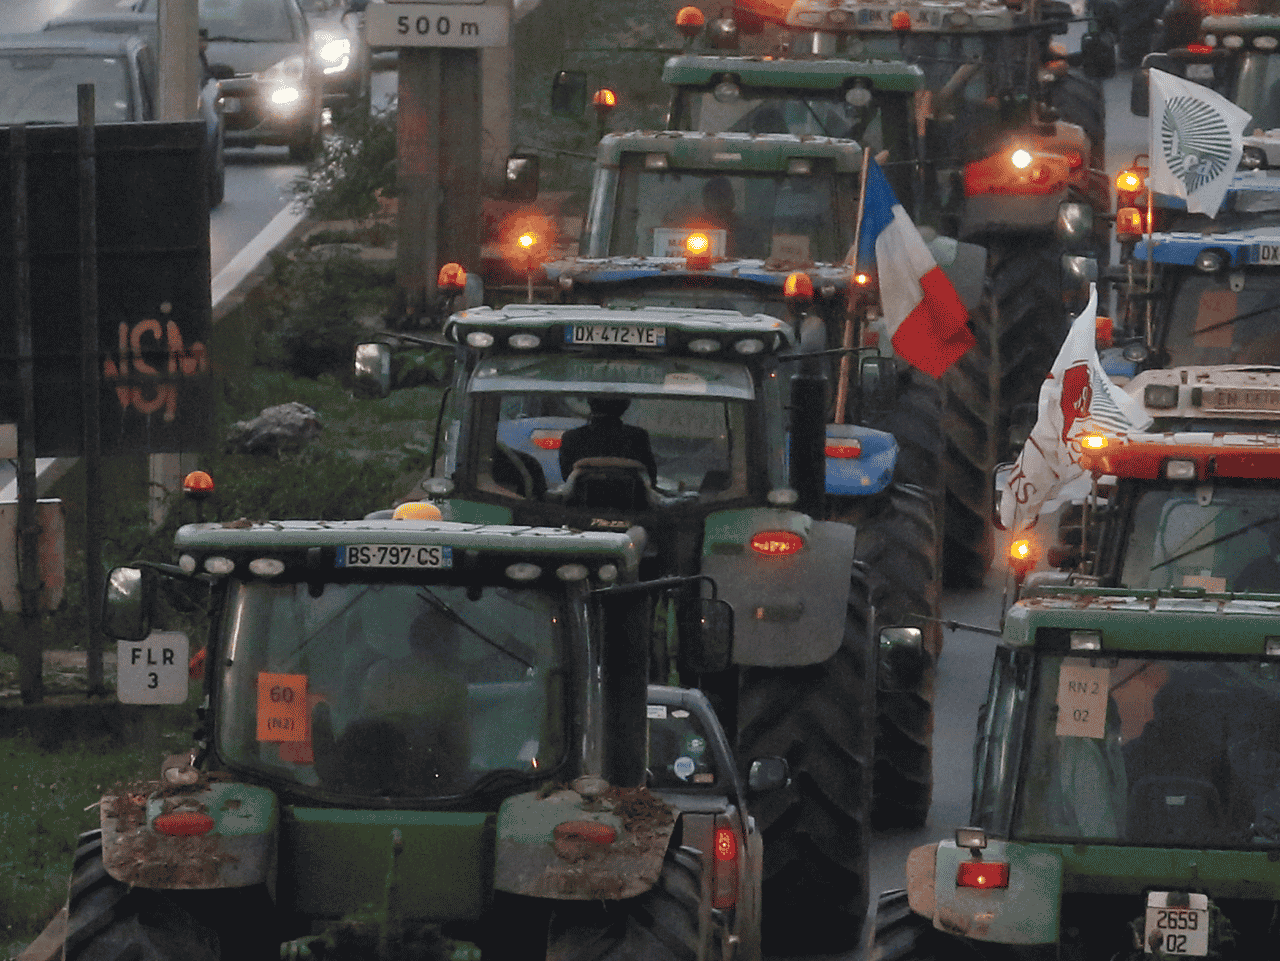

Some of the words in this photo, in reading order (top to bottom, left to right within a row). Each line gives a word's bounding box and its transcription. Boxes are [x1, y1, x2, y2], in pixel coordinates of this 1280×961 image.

[397, 14, 453, 37] 500
[459, 21, 481, 37] m
[348, 546, 440, 566] BS-797-CS
[130, 647, 176, 667] FLR
[147, 672, 160, 690] 3
[1067, 680, 1088, 694] RN
[1090, 681, 1100, 695] 2
[269, 686, 296, 705] 60
[1072, 708, 1090, 724] 02
[1156, 909, 1199, 931] 2659
[1166, 934, 1189, 953] 02
